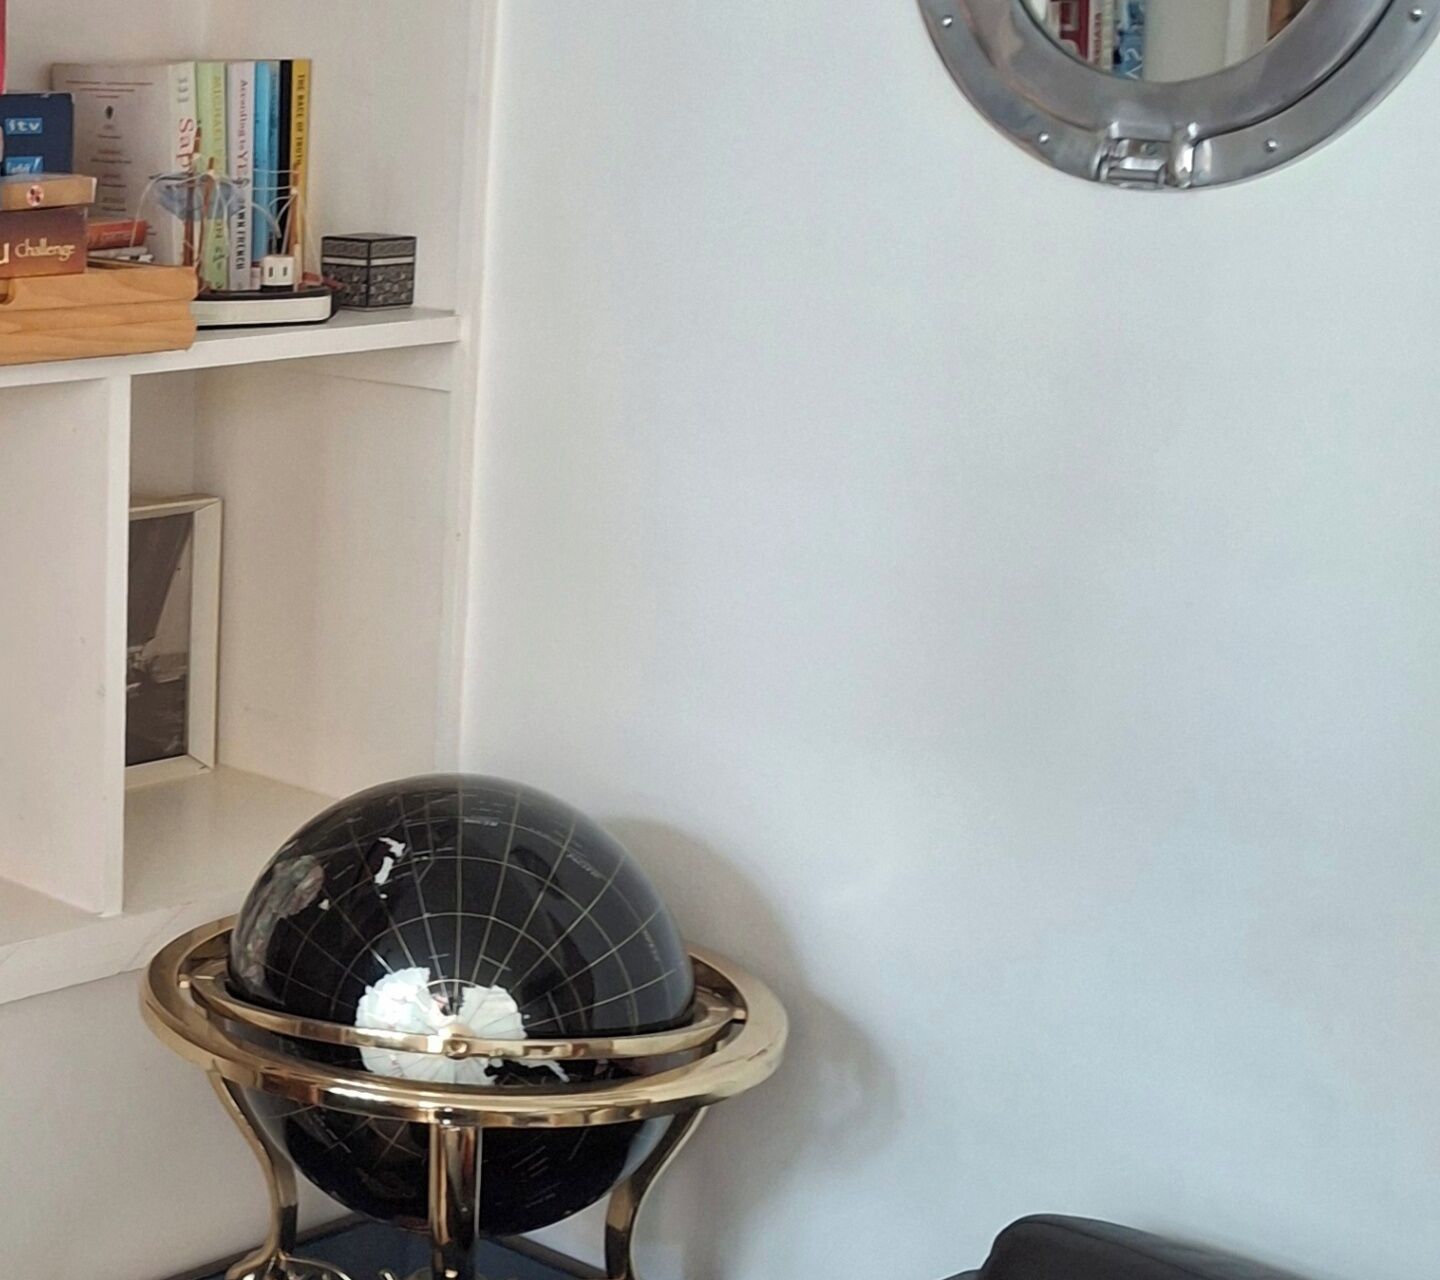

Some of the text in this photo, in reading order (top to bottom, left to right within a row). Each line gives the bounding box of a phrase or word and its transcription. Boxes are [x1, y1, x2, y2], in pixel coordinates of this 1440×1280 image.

[297, 74, 305, 90] THE
[297, 94, 305, 117] RACE
[296, 122, 304, 133] OF
[15, 238, 76, 262] Challenge
[236, 230, 246, 270] FRENCH
